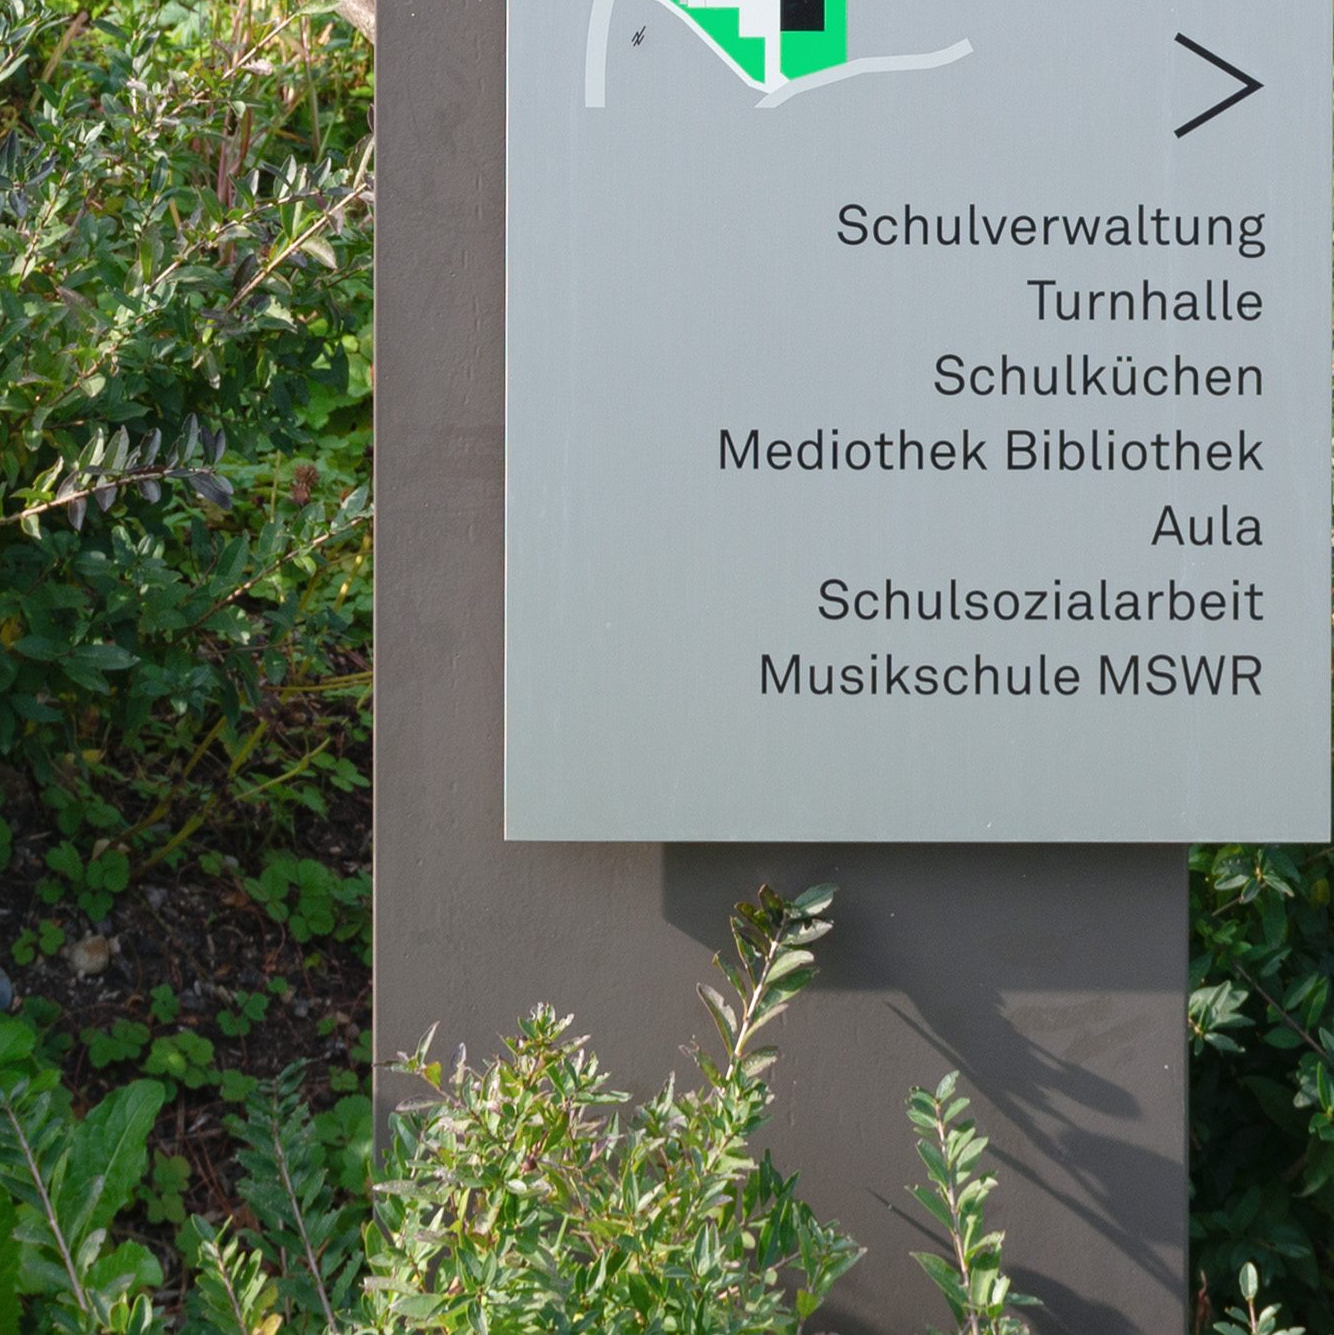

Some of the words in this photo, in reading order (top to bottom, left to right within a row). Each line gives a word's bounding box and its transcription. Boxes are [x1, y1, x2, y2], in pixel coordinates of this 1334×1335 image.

[838, 204, 1265, 258] Schulverwaltung
[1027, 280, 1262, 321] Turnhalle
[935, 355, 1261, 396] Schulküchen
[721, 429, 987, 470] Mediothek
[1008, 430, 1263, 471] Bibliothek
[1152, 505, 1262, 546] Aula
[819, 579, 1263, 620] Schulsozialarbeit
[762, 654, 1079, 695] Musikschule
[1101, 655, 1261, 695] MSWR
